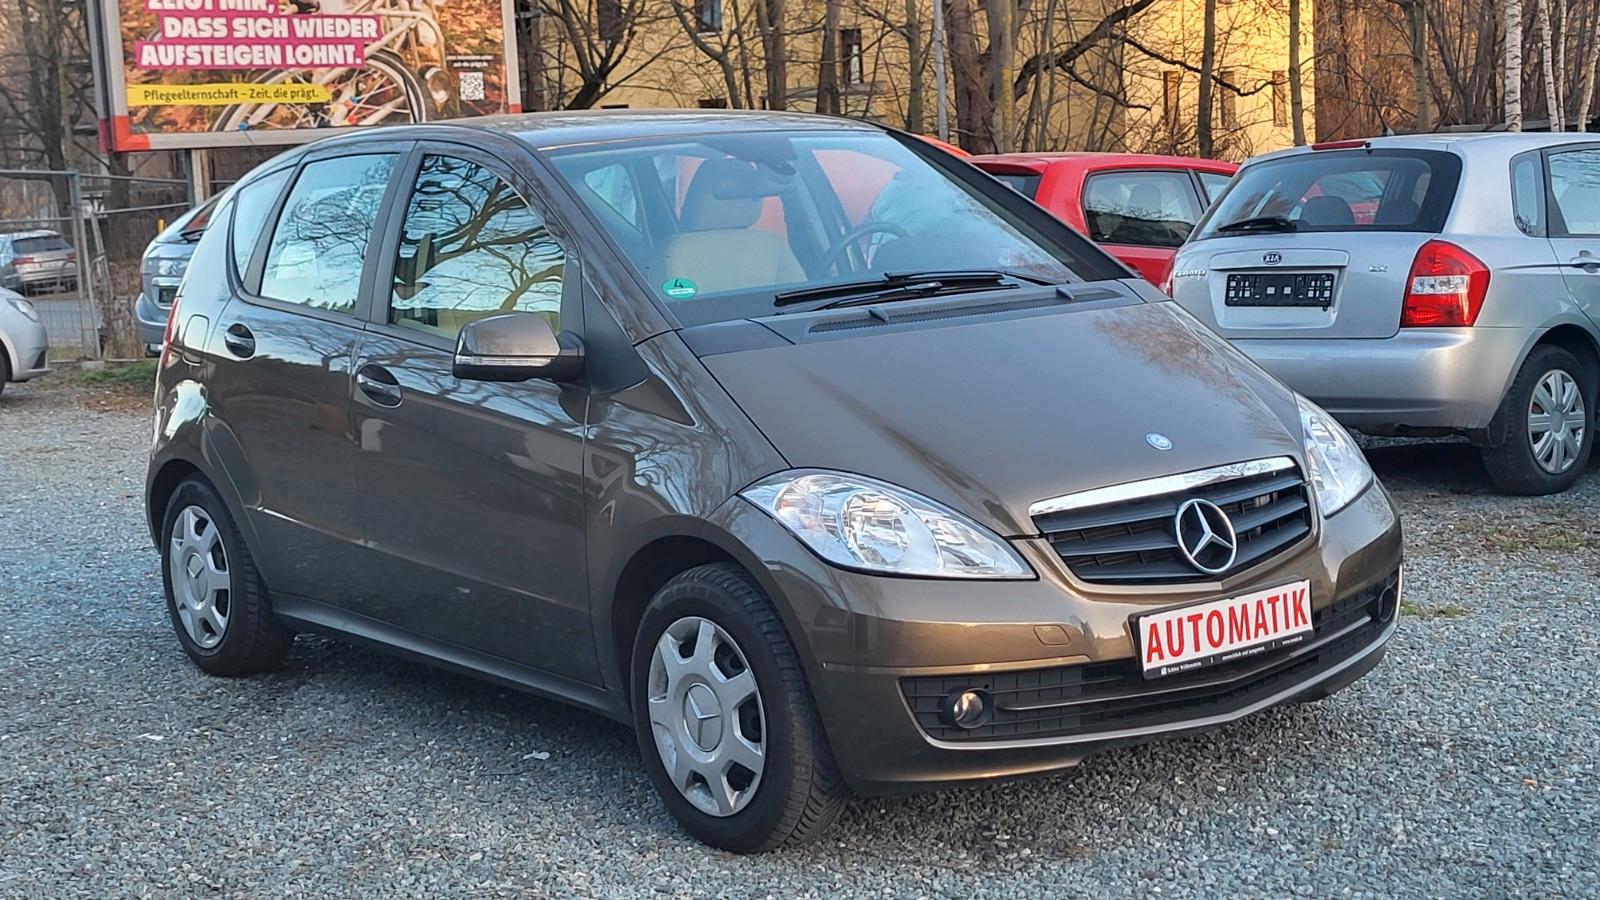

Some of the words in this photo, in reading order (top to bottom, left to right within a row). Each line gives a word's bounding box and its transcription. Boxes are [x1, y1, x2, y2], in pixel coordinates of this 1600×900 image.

[163, 17, 228, 38] DASS
[232, 17, 289, 38] SICH
[292, 17, 378, 38] WIEDER
[141, 44, 282, 66] AUFSTEIGEN
[285, 44, 362, 65] LOHNT.
[144, 88, 239, 103] Pflegeelternschaft
[273, 88, 288, 98] die
[1265, 253, 1280, 262] KIA
[673, 279, 684, 288] 4
[1146, 587, 1309, 664] AUTOMATIK
